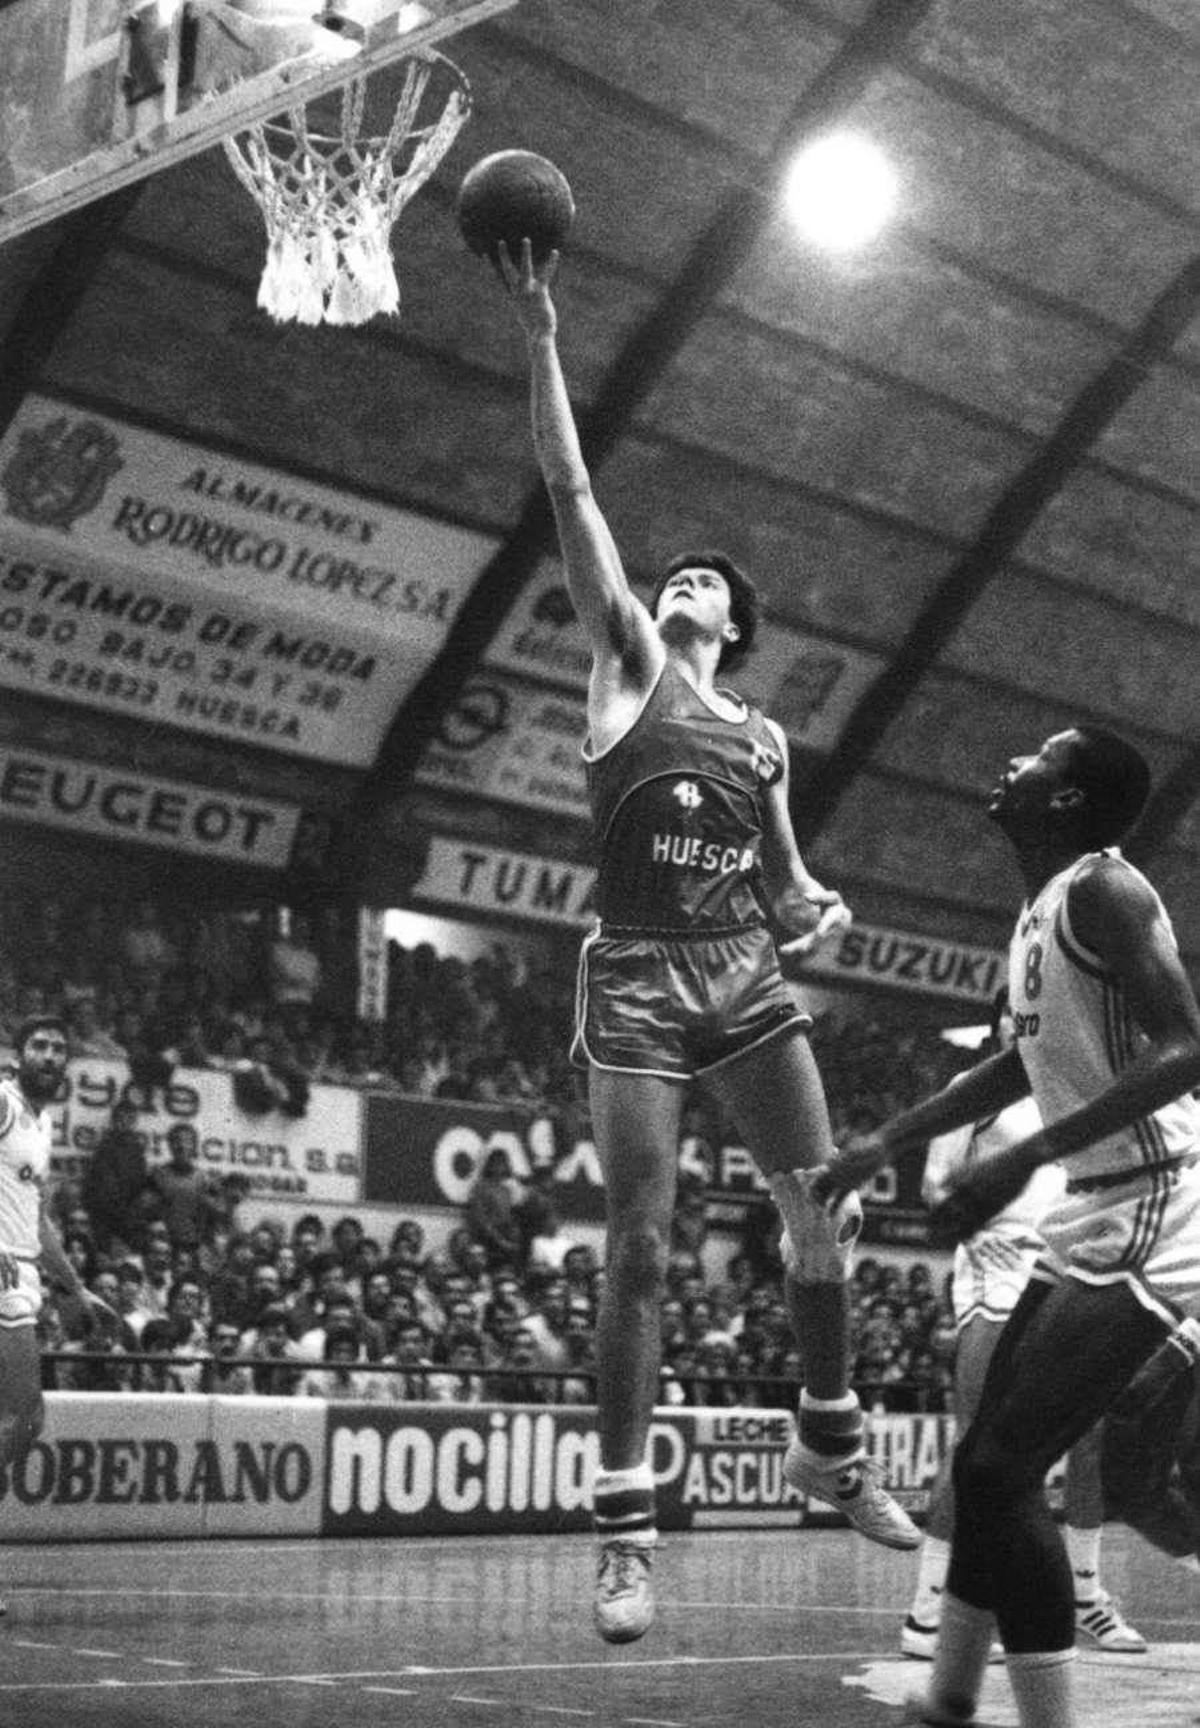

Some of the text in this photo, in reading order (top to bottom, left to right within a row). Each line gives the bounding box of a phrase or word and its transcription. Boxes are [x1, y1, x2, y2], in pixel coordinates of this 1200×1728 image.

[111, 496, 287, 573] RODRIGO
[179, 468, 377, 543] ALMACENES
[0, 555, 376, 682] STAMOS DE MODA
[176, 689, 300, 738] HUESCA
[2, 757, 275, 851] EUGEOT
[652, 833, 756, 873] HUESCA
[834, 929, 998, 994] SUZUKI
[329, 1411, 601, 1515] nocilla
[713, 1416, 790, 1442] LECHE
[0, 1438, 312, 1506] OBERANO
